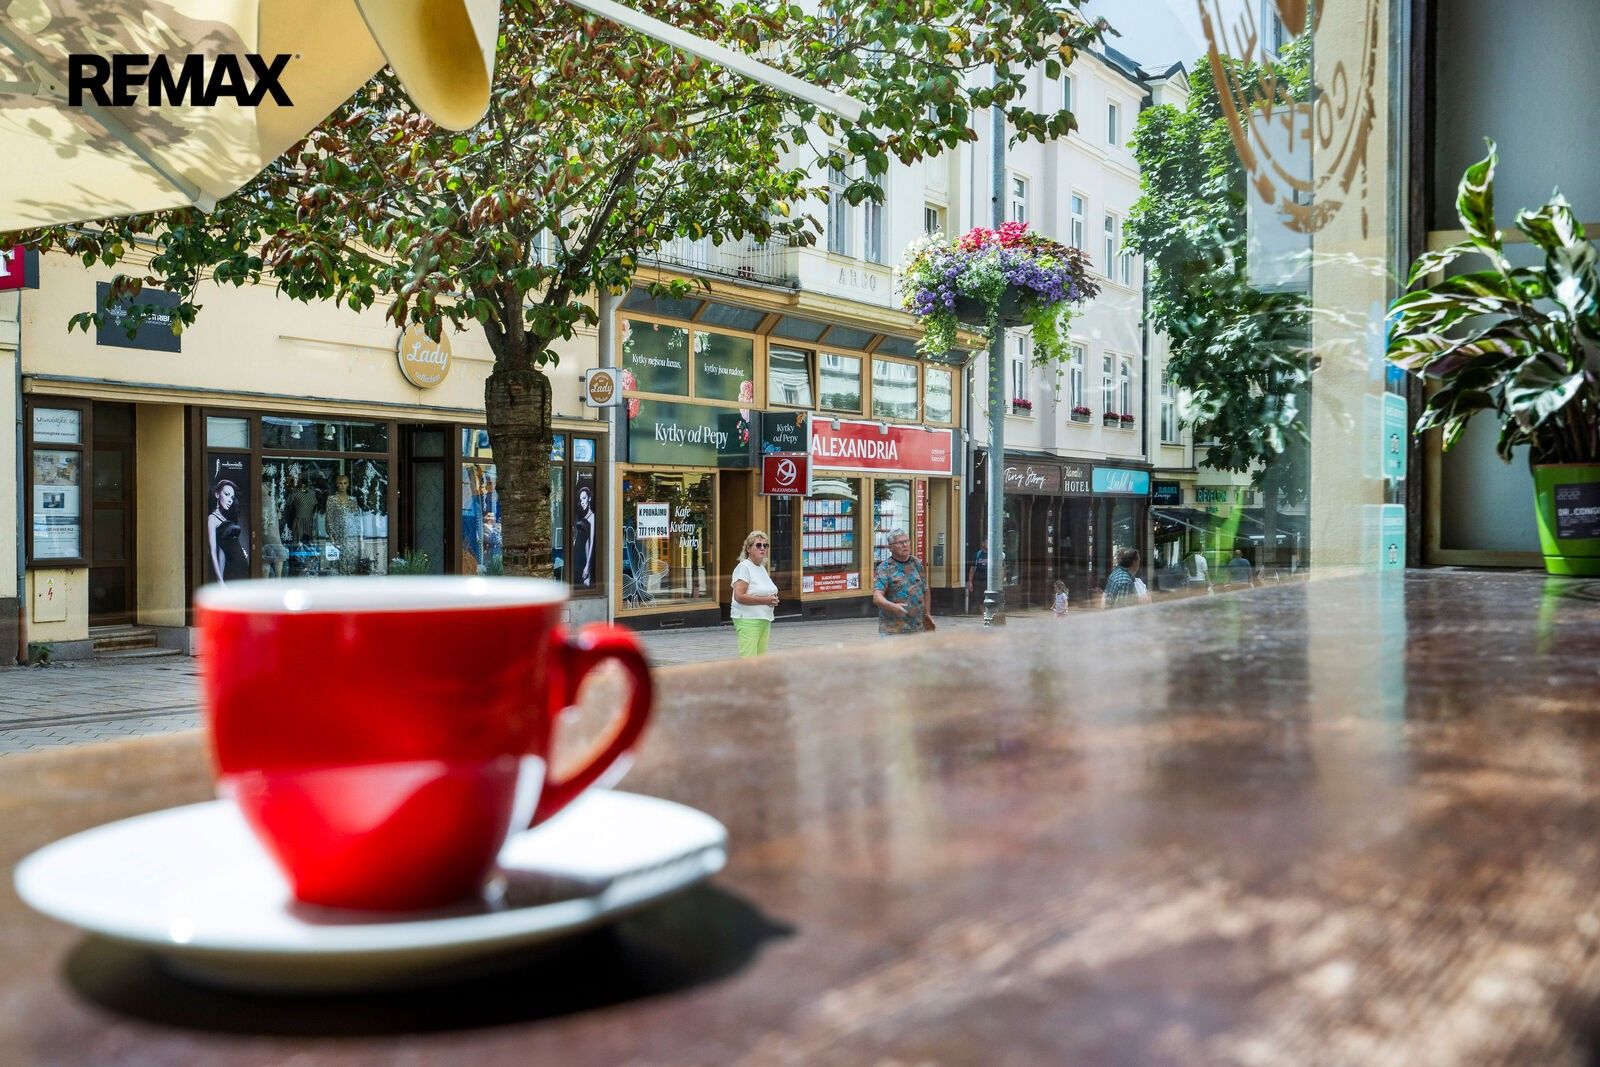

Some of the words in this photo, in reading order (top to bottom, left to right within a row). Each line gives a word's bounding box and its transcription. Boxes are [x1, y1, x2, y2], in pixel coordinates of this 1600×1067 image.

[407, 342, 448, 371] Lady
[632, 354, 648, 367] Kytky
[648, 357, 666, 368] nejsou
[704, 363, 718, 375] kytky
[718, 366, 729, 375] jsou
[591, 382, 613, 395] Lady
[776, 424, 795, 434] Kytky
[655, 423, 687, 446] Kytky
[688, 425, 702, 443] od
[703, 427, 729, 449] Pepy
[773, 433, 782, 442] od
[782, 435, 798, 444] Pepy
[811, 434, 898, 460] ALEXANDRIA
[1004, 467, 1024, 488] Tiny
[1025, 466, 1047, 489] Story
[1064, 481, 1090, 492] HOTEL
[639, 508, 643, 517] K
[675, 505, 691, 519] Kafe
[639, 526, 647, 536] 777
[648, 527, 656, 536] 111
[657, 526, 667, 536] 894
[670, 520, 696, 536] Květiny
